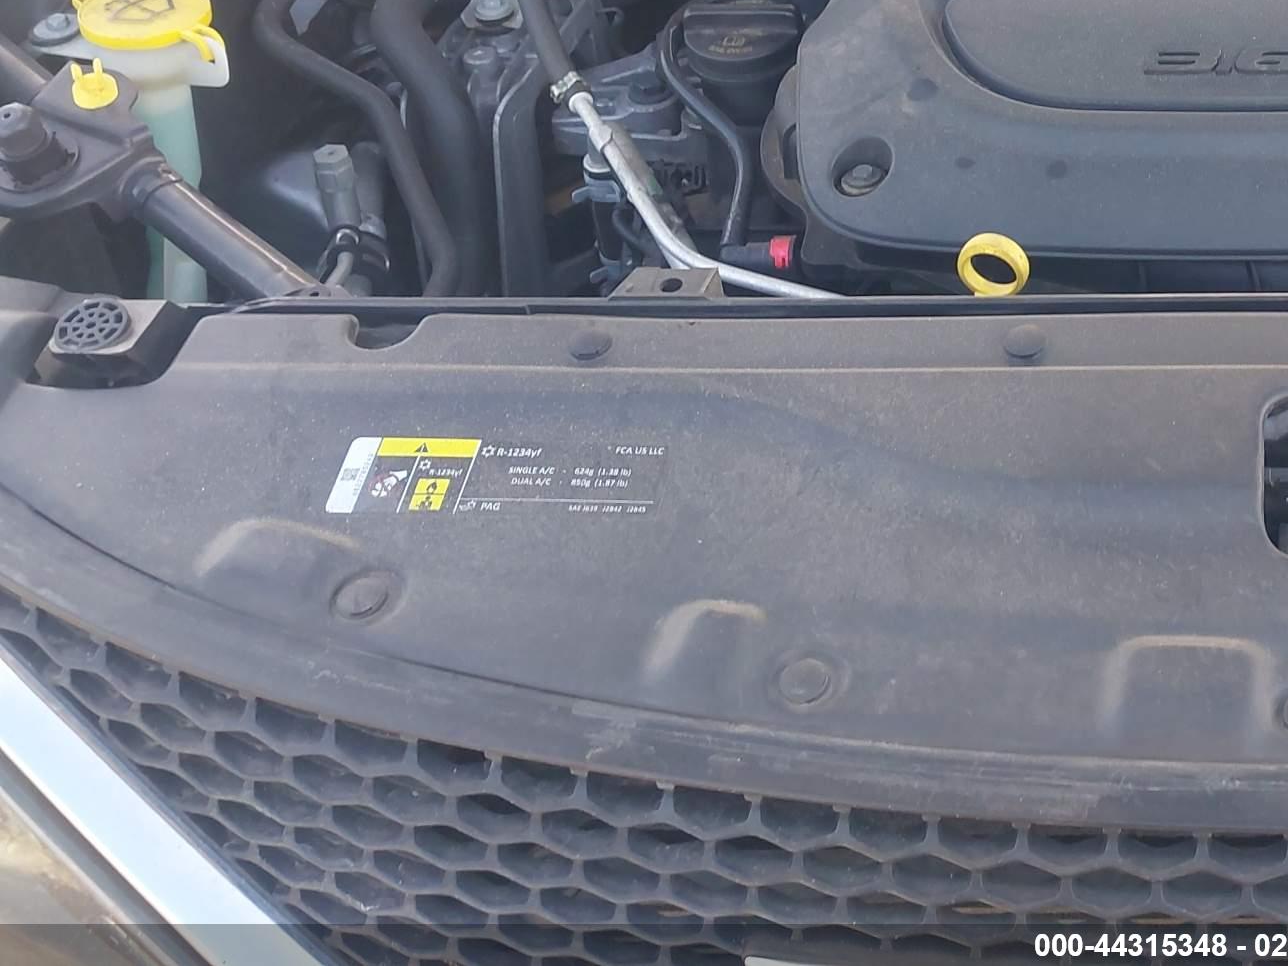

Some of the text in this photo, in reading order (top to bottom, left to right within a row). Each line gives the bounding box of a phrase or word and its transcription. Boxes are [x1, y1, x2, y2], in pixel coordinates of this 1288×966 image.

[497, 448, 542, 459] R-1234yf
[616, 446, 665, 456] FCA US LLC
[508, 466, 537, 475] SINGLE
[538, 466, 555, 475] A/C
[511, 477, 533, 486] DUAL
[535, 478, 552, 487] A/C
[480, 502, 501, 511] PAG
